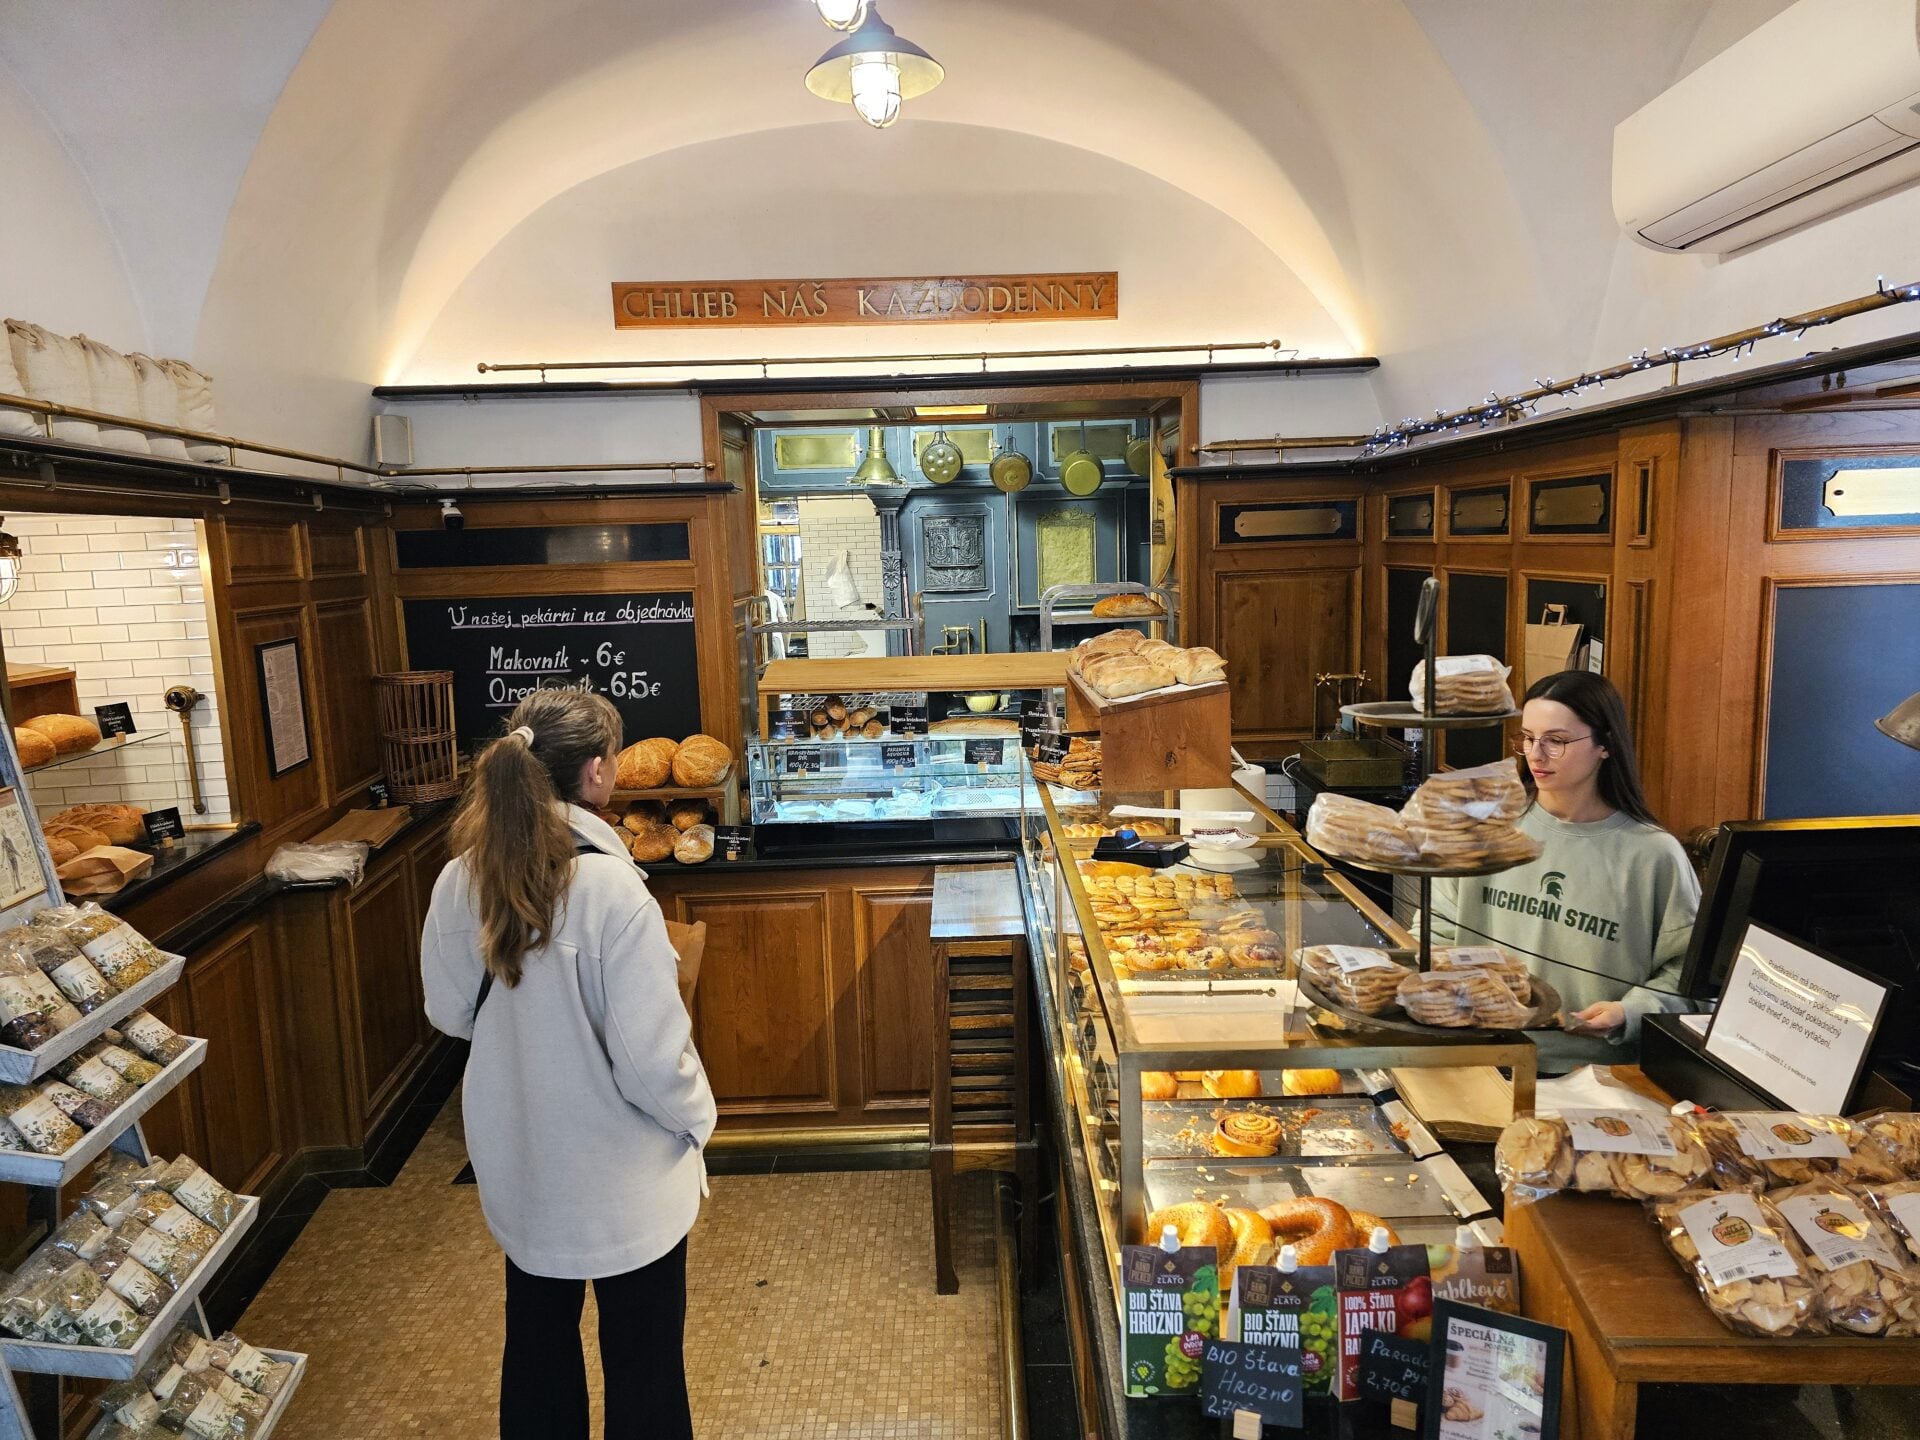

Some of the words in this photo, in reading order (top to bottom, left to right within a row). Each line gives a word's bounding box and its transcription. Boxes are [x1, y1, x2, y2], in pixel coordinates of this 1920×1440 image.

[622, 290, 738, 320] CHLIEB
[762, 282, 828, 318] NÁŠ
[471, 611, 512, 628] našej
[521, 607, 577, 629] pekárni
[583, 610, 606, 622] na
[616, 598, 695, 624] objednávku
[489, 645, 569, 670] Makovník
[596, 641, 626, 667] 6€
[610, 671, 661, 700] 6,5€
[1482, 886, 1562, 922] MICHIGAN
[1564, 908, 1620, 942] STATE
[1157, 1277, 1185, 1285] ZLATO
[1371, 1278, 1399, 1287] ZLATO
[1431, 1278, 1508, 1301] ablkové
[1129, 1292, 1147, 1310] BIO
[1150, 1289, 1183, 1311] ŠŤAVA
[1344, 1296, 1367, 1310] 100%
[1369, 1292, 1395, 1310] ŠŤAVA
[1129, 1311, 1184, 1335] HROZNO
[1244, 1313, 1263, 1331] BIO
[1265, 1309, 1299, 1331] ŠŤAVA
[1345, 1310, 1396, 1335] JABLKO
[1206, 1345, 1238, 1365] BIO
[1367, 1371, 1412, 1397] 2,70€
